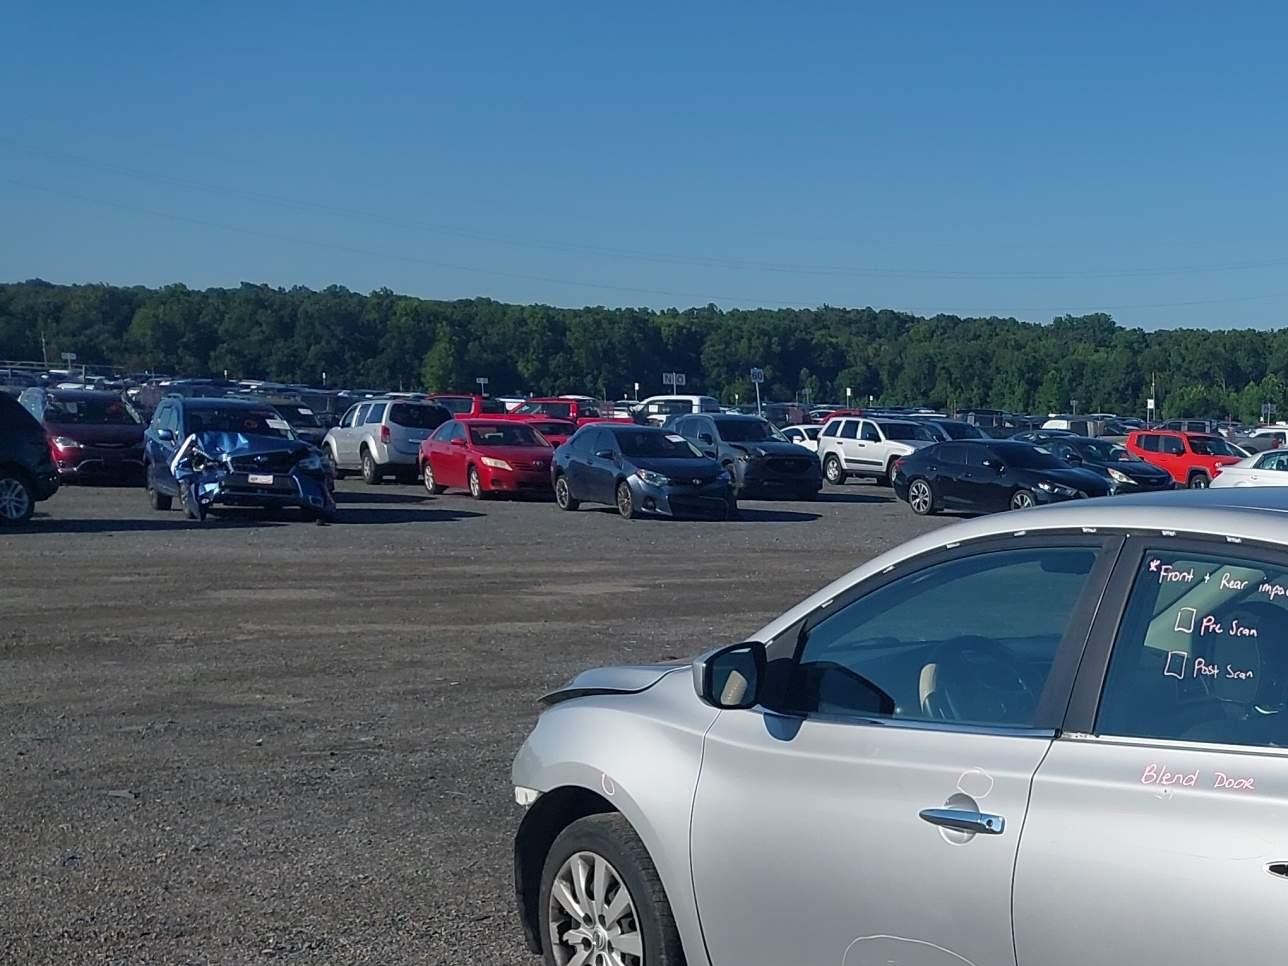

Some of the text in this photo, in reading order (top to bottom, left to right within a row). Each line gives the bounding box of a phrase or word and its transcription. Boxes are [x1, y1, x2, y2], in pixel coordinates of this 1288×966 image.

[1219, 573, 1249, 591] Rear
[1200, 615, 1258, 638] Pre Scan
[1193, 659, 1254, 680] Post Scan
[1140, 763, 1199, 786] Blend
